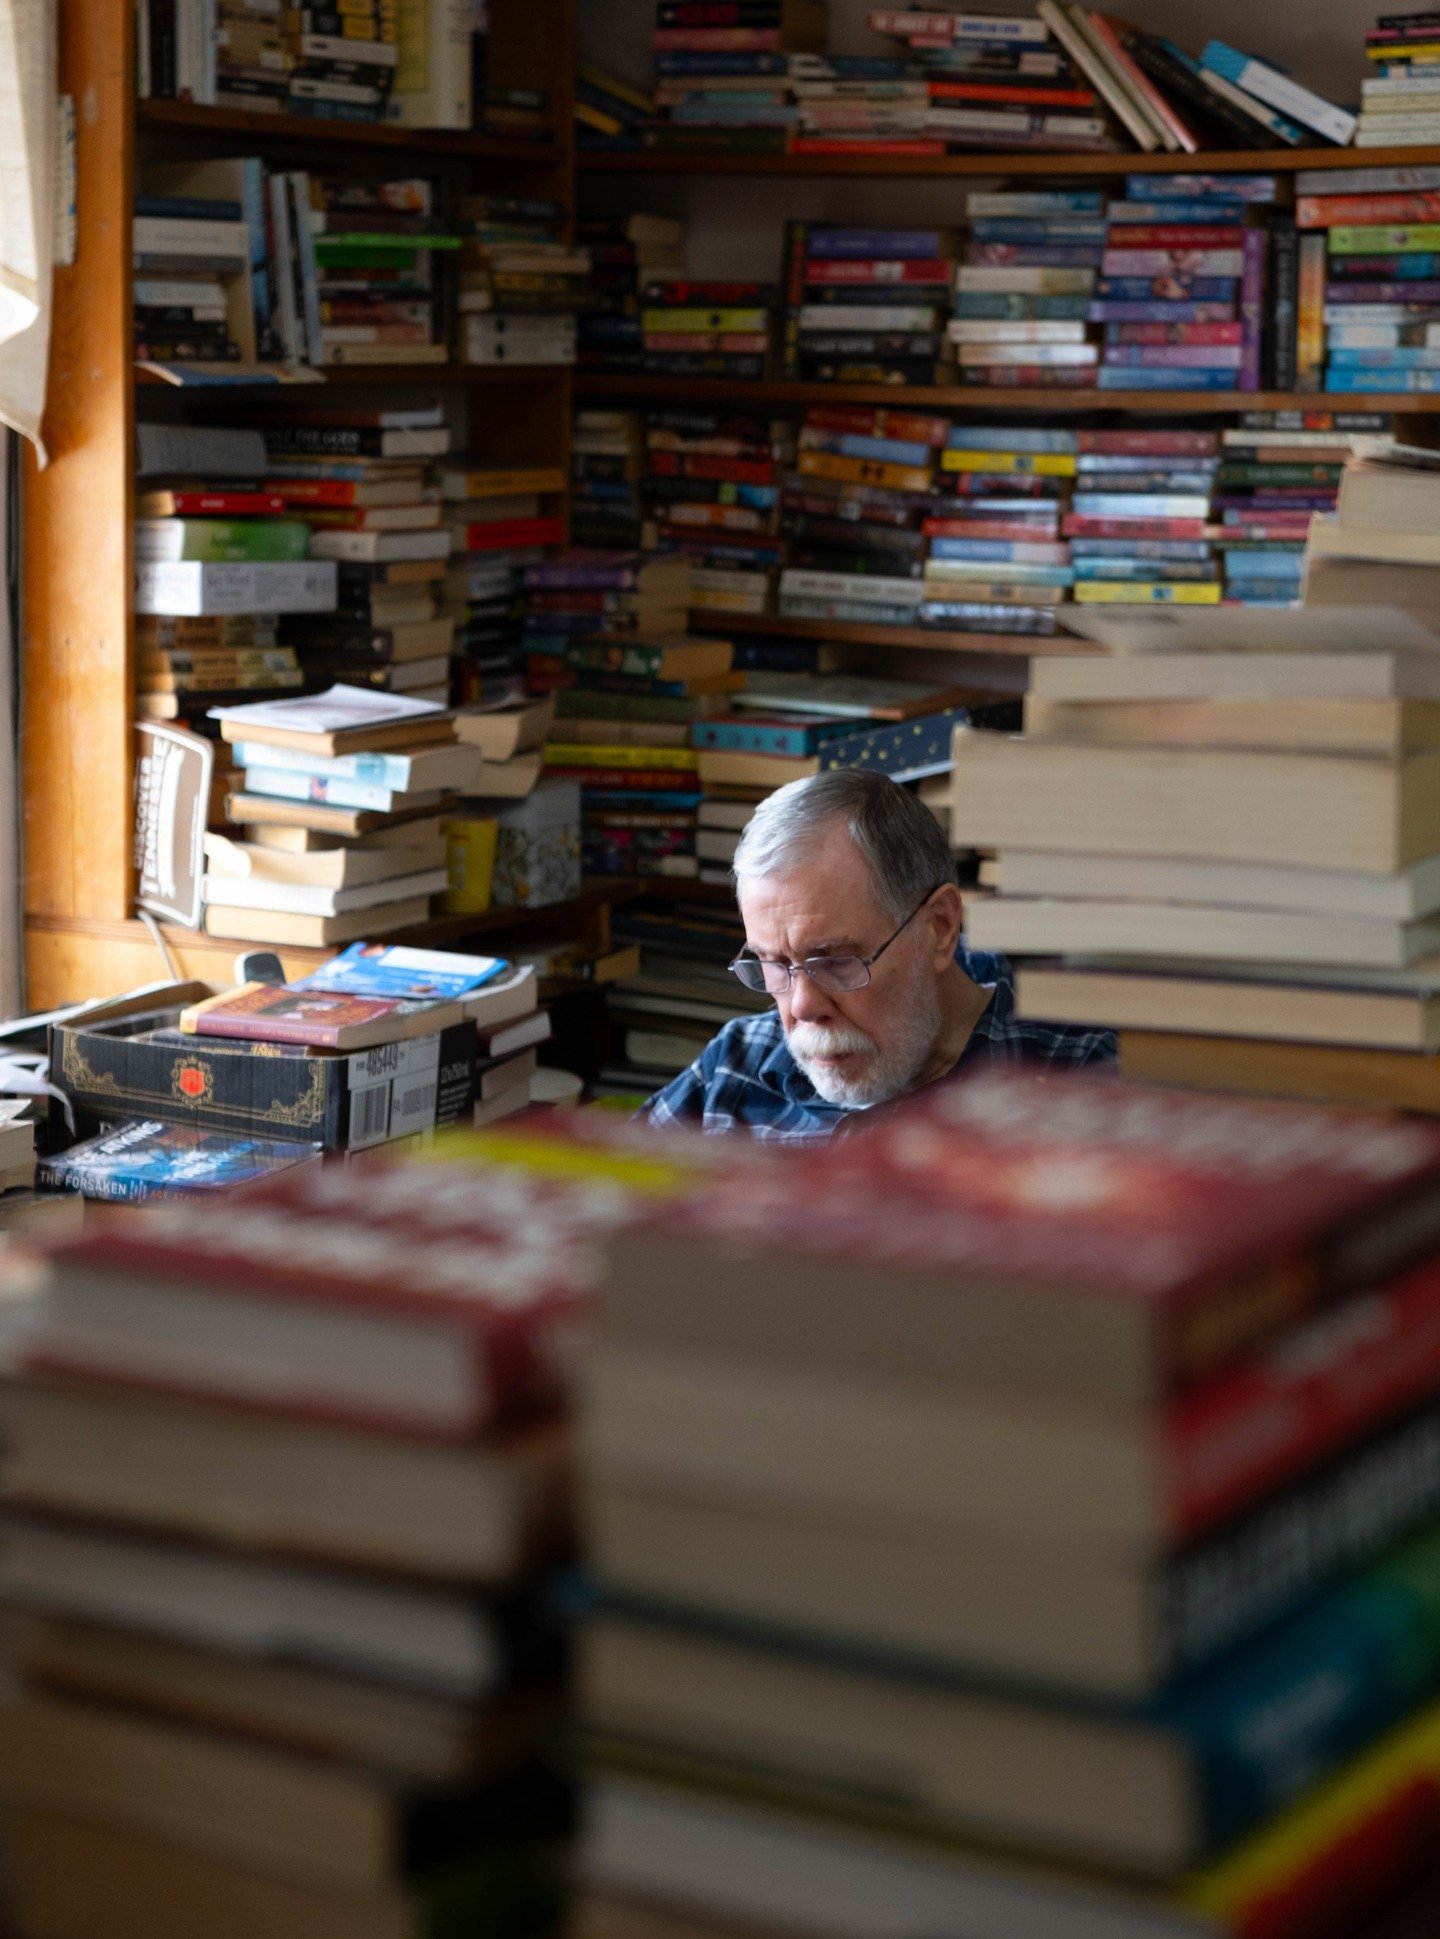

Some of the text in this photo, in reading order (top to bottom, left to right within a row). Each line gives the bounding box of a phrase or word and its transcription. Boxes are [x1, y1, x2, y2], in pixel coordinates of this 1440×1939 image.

[134, 756, 153, 870] DISCOVER
[39, 1170, 62, 1186] THE
[65, 1174, 127, 1196] FORSAKEN
[150, 1188, 168, 1200] ACE
